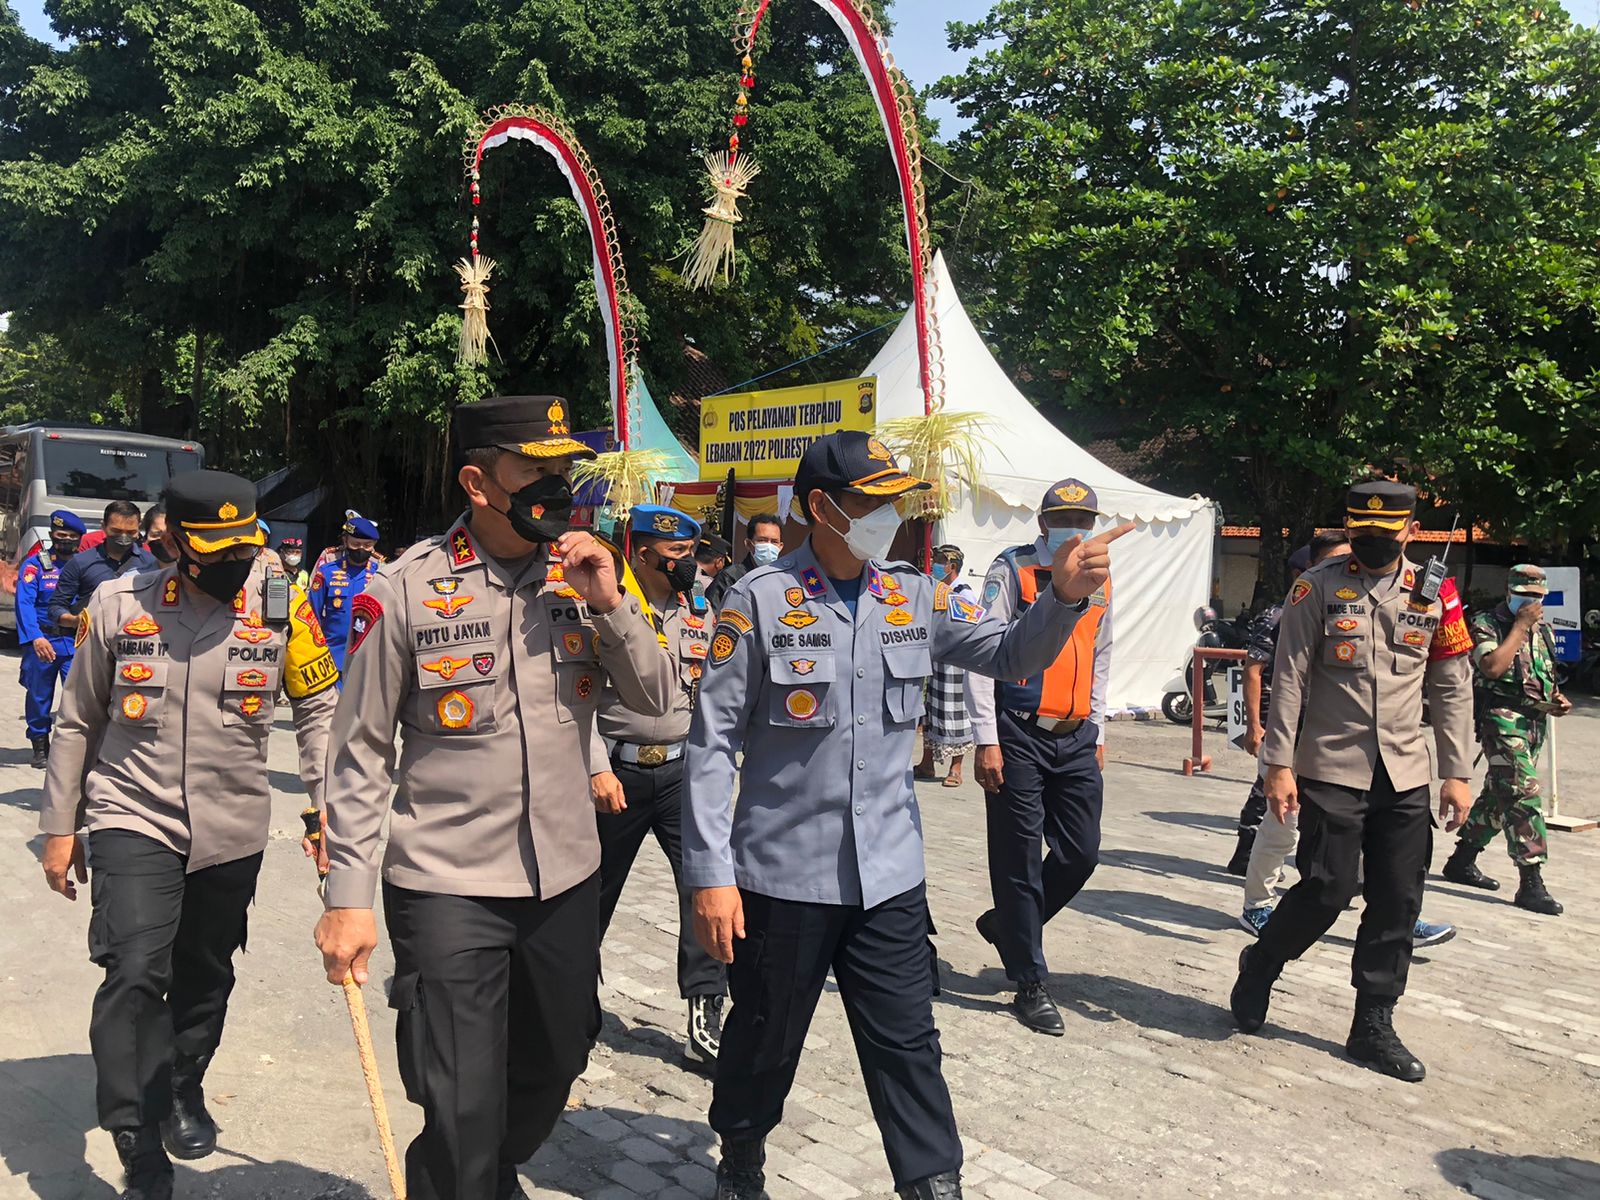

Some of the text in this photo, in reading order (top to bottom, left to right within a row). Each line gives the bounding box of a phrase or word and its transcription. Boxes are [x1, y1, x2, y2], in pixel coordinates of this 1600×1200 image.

[729, 400, 842, 432] POS PELAYANAN TERPADU
[706, 441, 742, 463] LEBARAN
[744, 439, 767, 461] 2022
[551, 606, 591, 622] POL
[1398, 612, 1439, 629] POLRI
[416, 621, 491, 646] PUTU JAYAN
[680, 627, 709, 642] POLRI
[772, 633, 832, 649] GDE SAMSI
[881, 627, 928, 645] DISHUB
[117, 640, 155, 656] BAMBANG
[228, 646, 279, 663] POLRI
[301, 654, 336, 687] KA OPS
